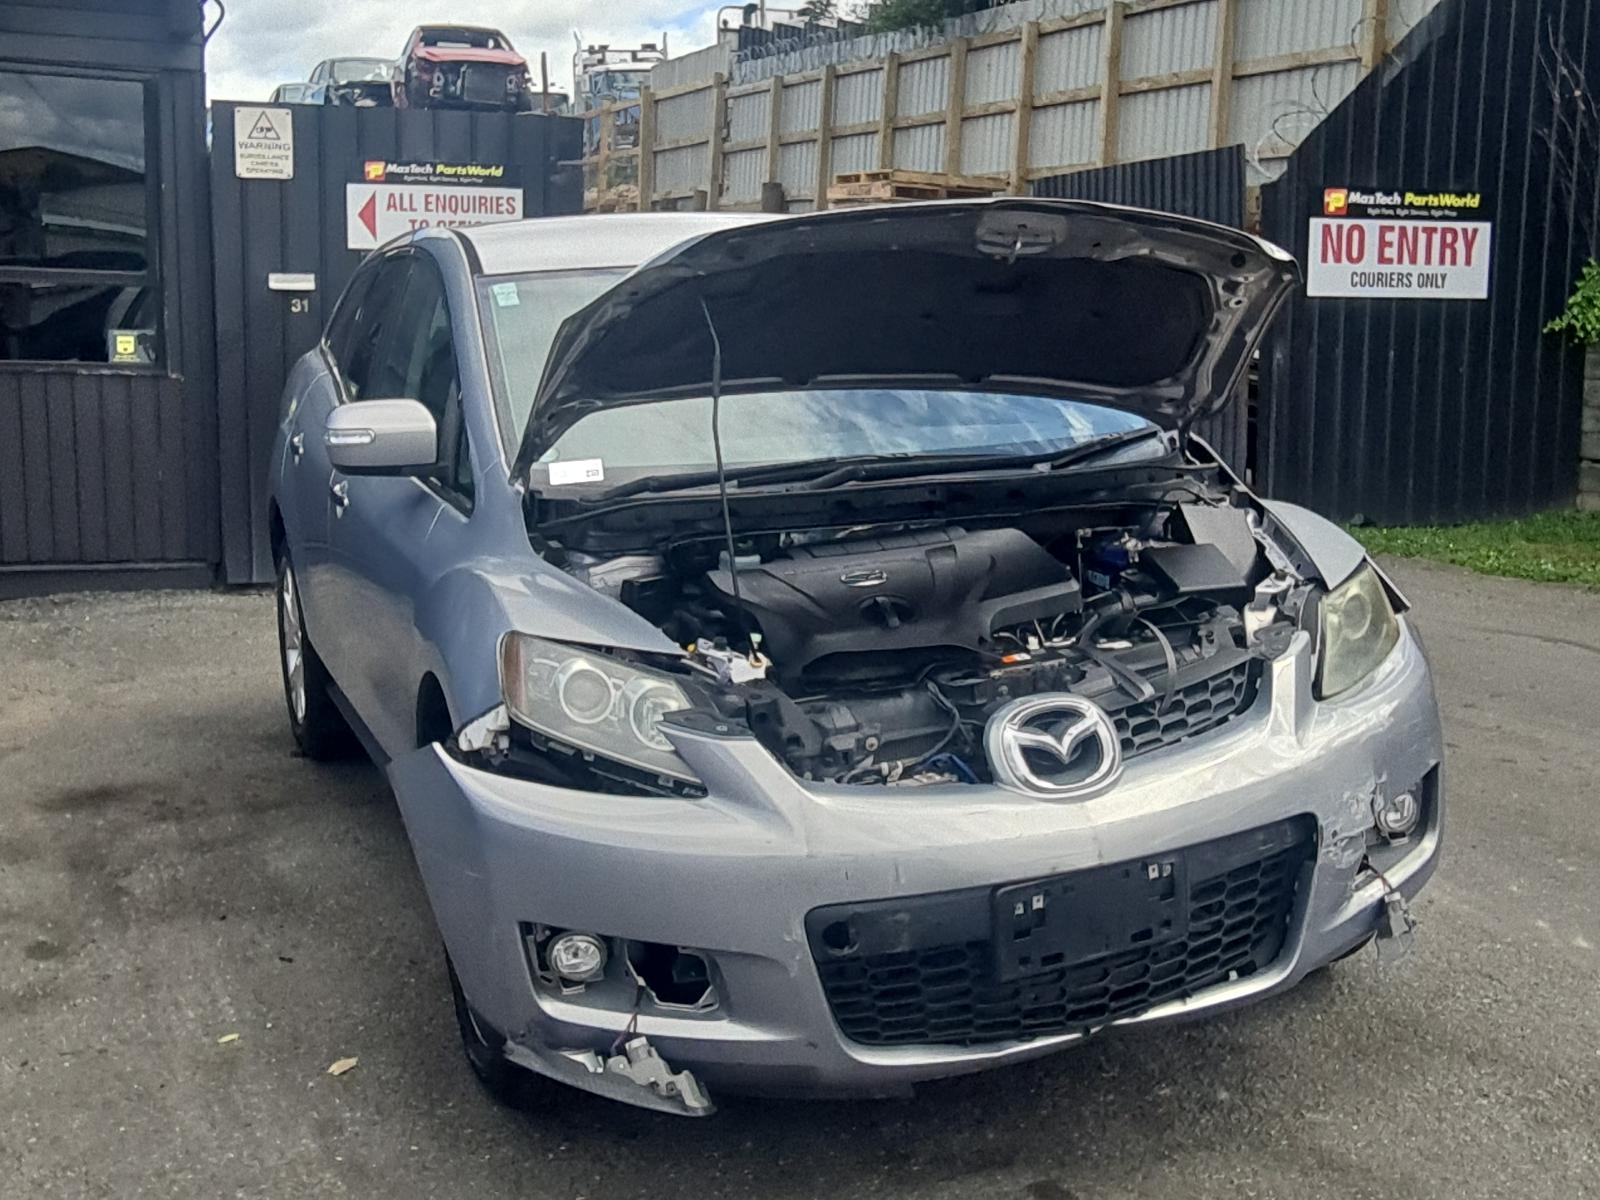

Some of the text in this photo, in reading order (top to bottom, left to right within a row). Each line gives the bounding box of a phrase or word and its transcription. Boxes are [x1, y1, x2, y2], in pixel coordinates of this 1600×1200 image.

[239, 141, 291, 152] WARNING
[386, 192, 516, 216] ALL ENQUIRIES
[1321, 224, 1479, 267] NO ENTRY
[1351, 271, 1448, 289] COURIERS ONLY
[291, 298, 309, 313] 31
